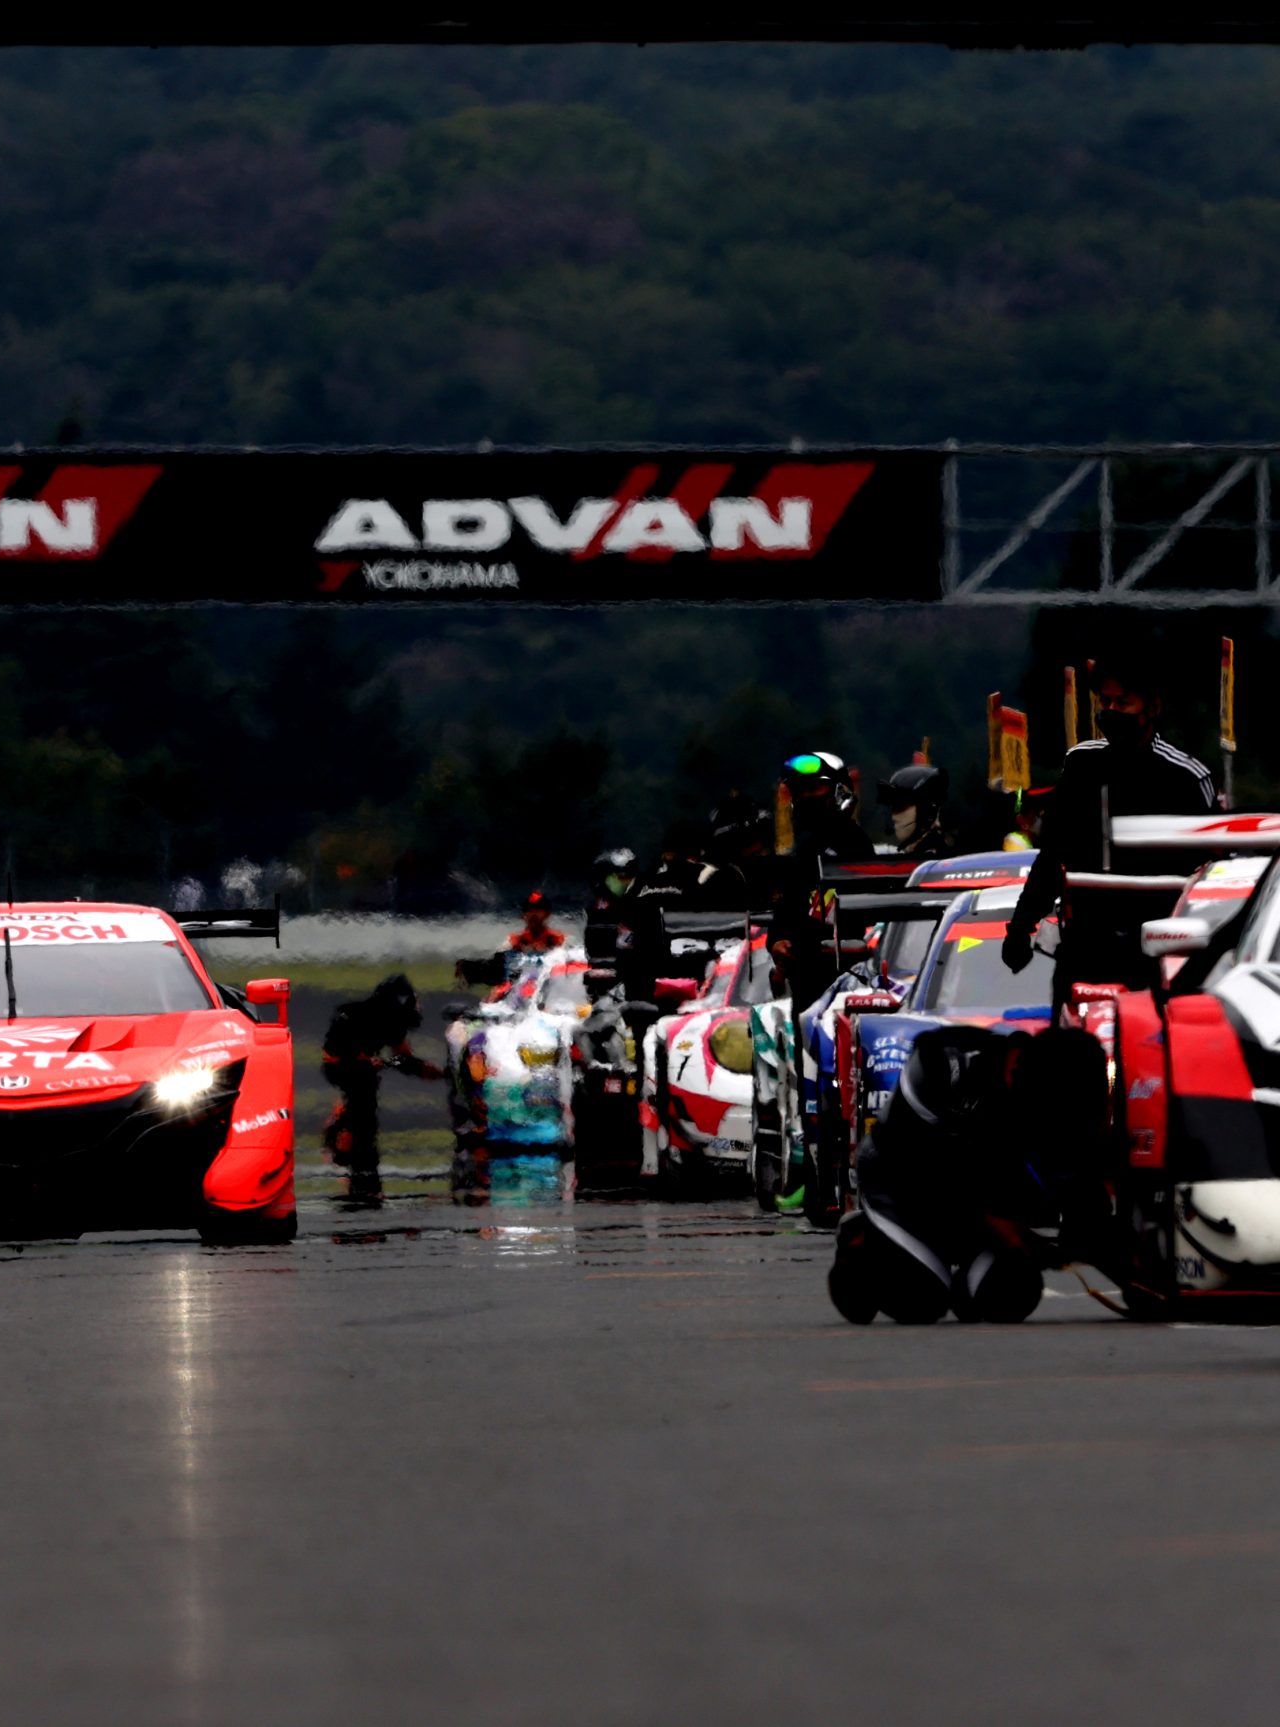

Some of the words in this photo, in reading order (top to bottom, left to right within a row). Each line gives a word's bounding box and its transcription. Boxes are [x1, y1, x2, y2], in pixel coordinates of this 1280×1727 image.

[313, 496, 813, 554] ADVAN
[362, 560, 520, 590] YOKOHAMA
[1074, 985, 1118, 996] TOTAL
[45, 1074, 132, 1091] CVSTOS
[232, 1110, 278, 1134] Mobil
